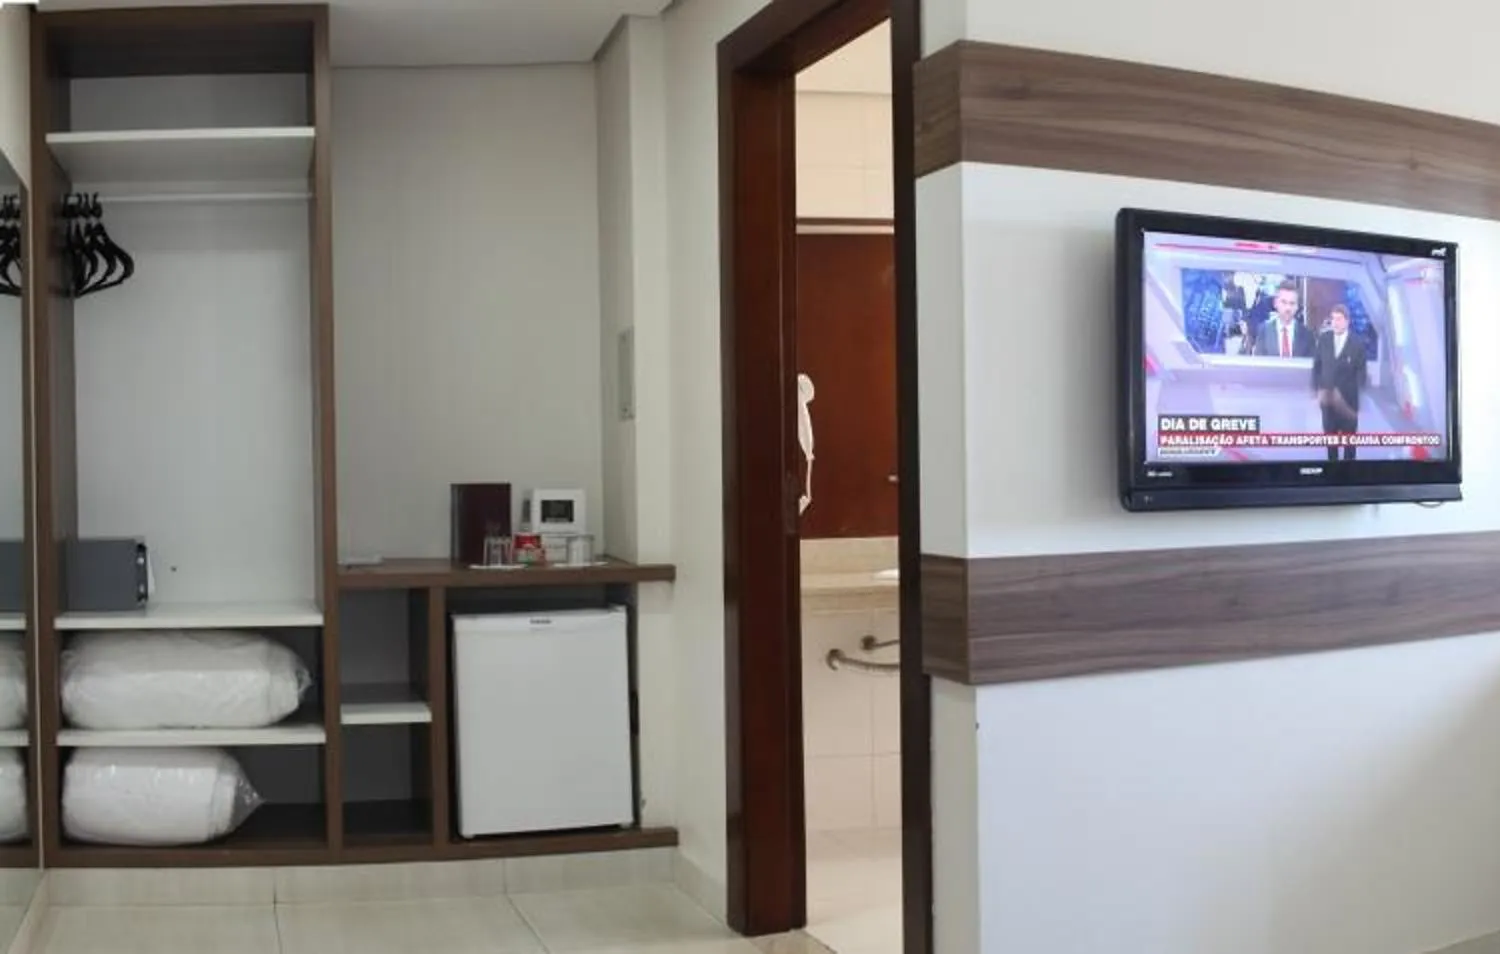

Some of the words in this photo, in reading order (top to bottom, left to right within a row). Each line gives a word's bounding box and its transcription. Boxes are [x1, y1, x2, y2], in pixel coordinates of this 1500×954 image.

[1161, 418, 1185, 431] DIA
[1189, 418, 1207, 431] DE
[1211, 418, 1257, 431] GREVE
[1235, 435, 1269, 445] AFETA
[1270, 435, 1338, 445] TRANSPORTES
[1349, 435, 1380, 445] CAUSA
